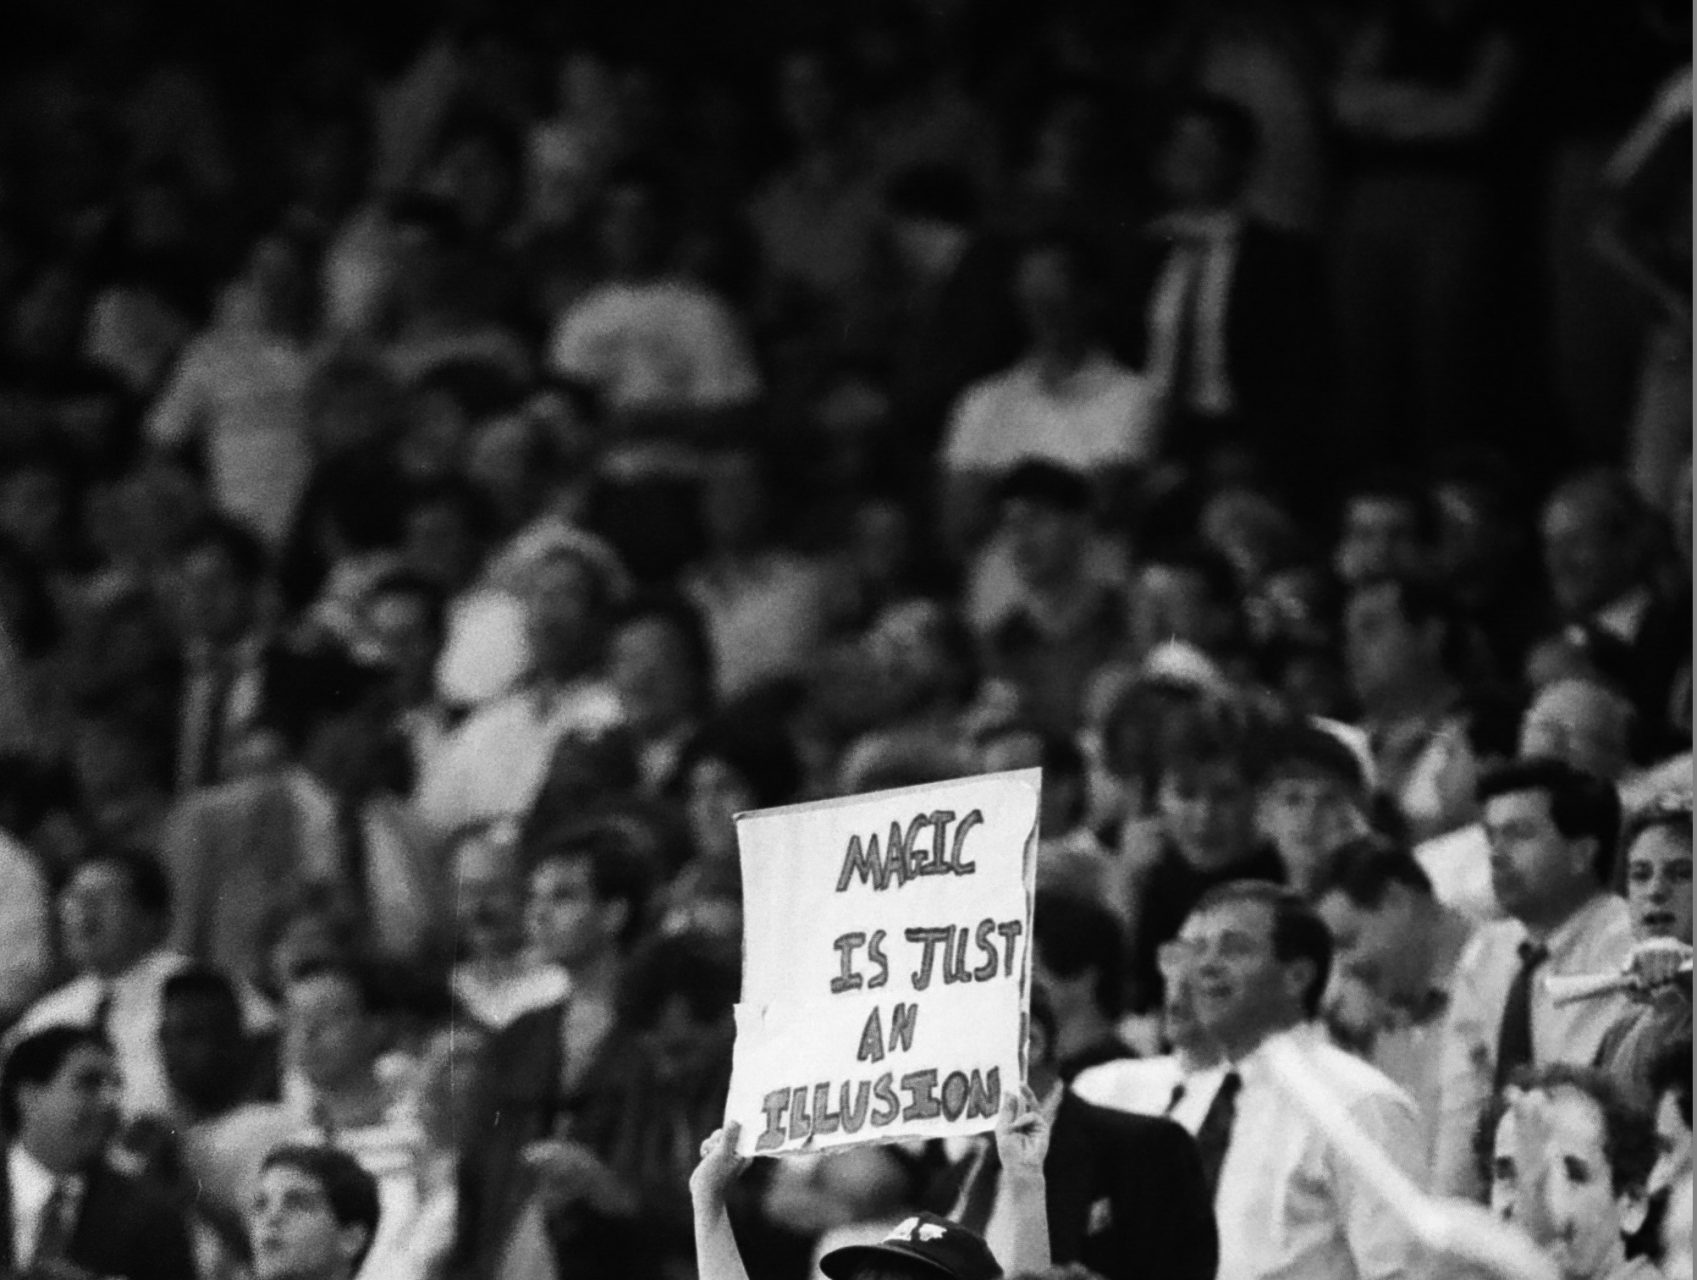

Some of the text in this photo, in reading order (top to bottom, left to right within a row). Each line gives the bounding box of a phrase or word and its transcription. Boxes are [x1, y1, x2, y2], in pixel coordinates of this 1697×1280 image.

[836, 809, 984, 891] MAGIC
[831, 918, 1022, 993] IS JUST
[857, 1002, 918, 1063] AN
[755, 1066, 1000, 1152] ILLUSION
